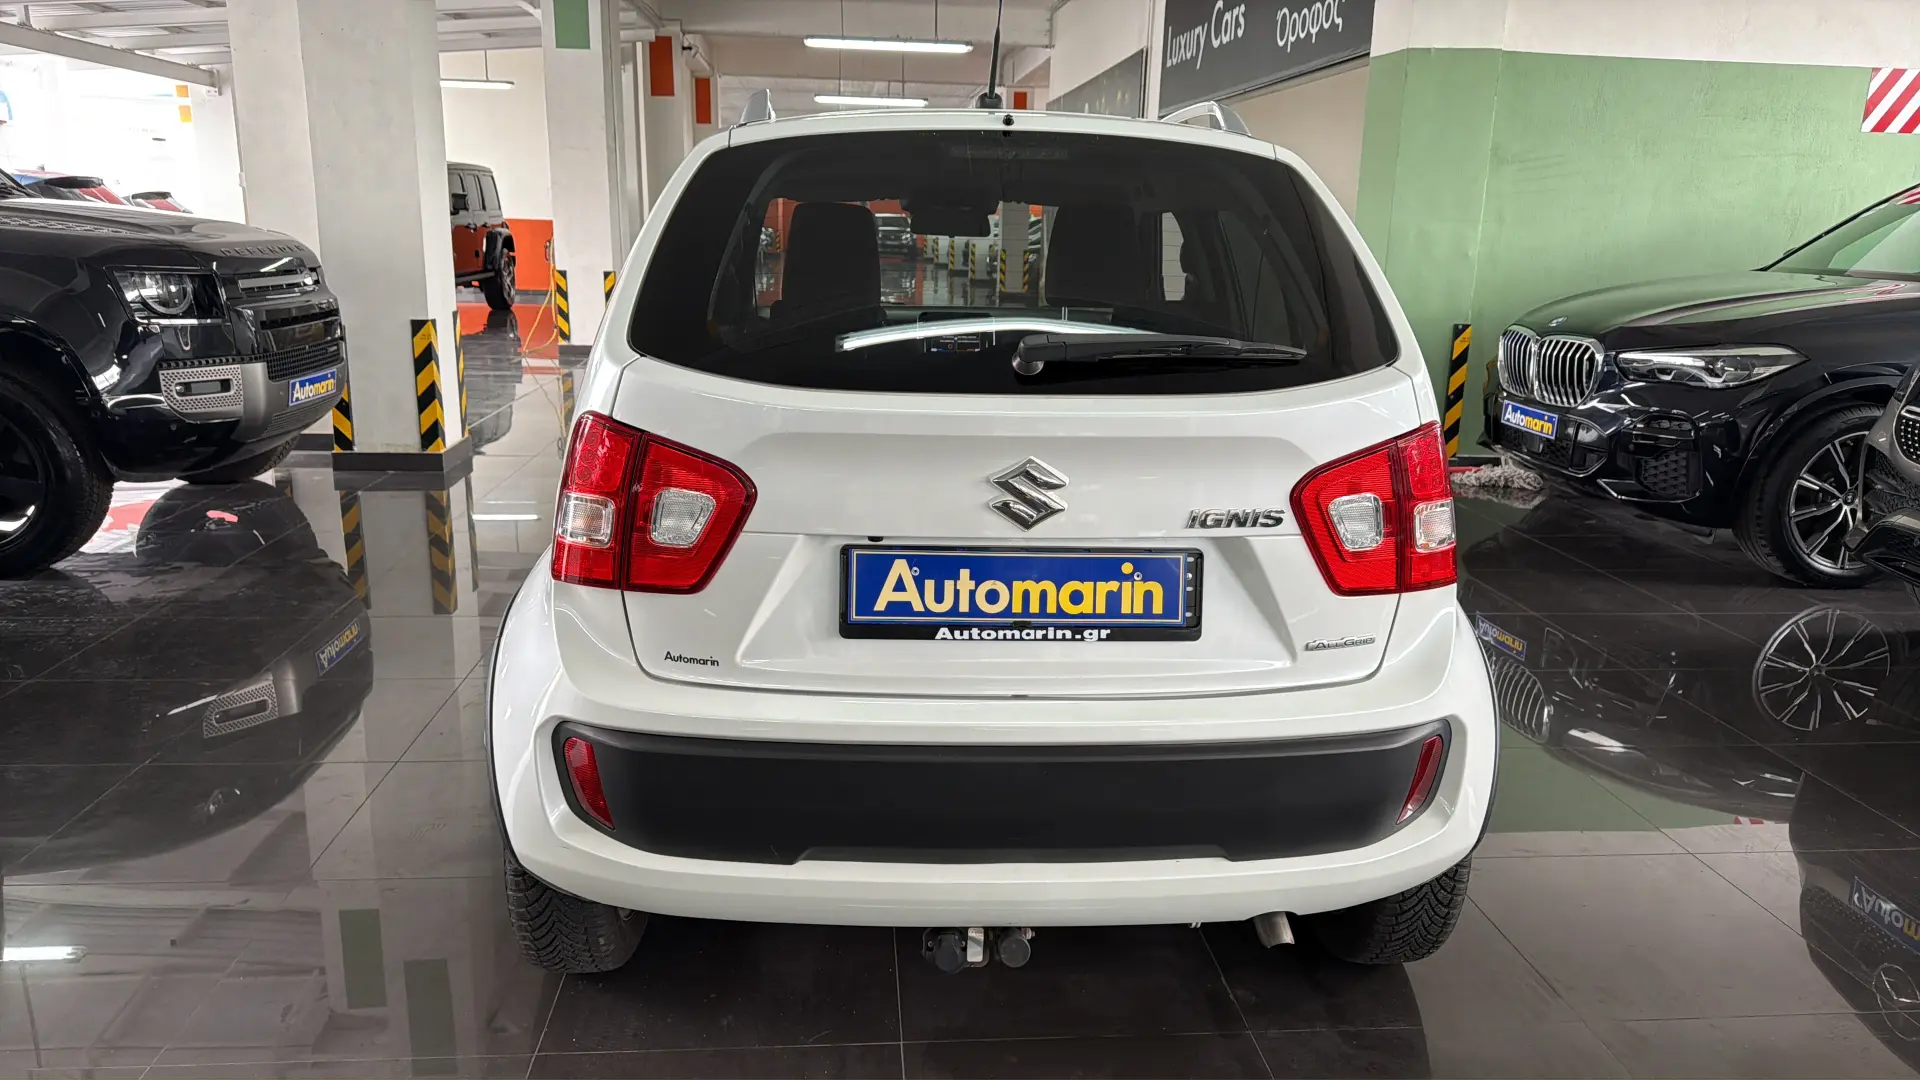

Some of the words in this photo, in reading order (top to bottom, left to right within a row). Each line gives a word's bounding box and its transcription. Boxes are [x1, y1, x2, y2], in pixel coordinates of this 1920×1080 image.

[1166, 22, 1208, 70] Luxury
[1211, 0, 1246, 48] Cars
[1276, 0, 1343, 53] Όροφος
[293, 374, 335, 400] Automarin
[1504, 405, 1552, 435] Automarin
[1186, 508, 1286, 529] IGNIS
[873, 559, 1163, 615] Automarin
[934, 626, 1111, 641] Automarin.gr
[664, 651, 719, 667] Automarin
